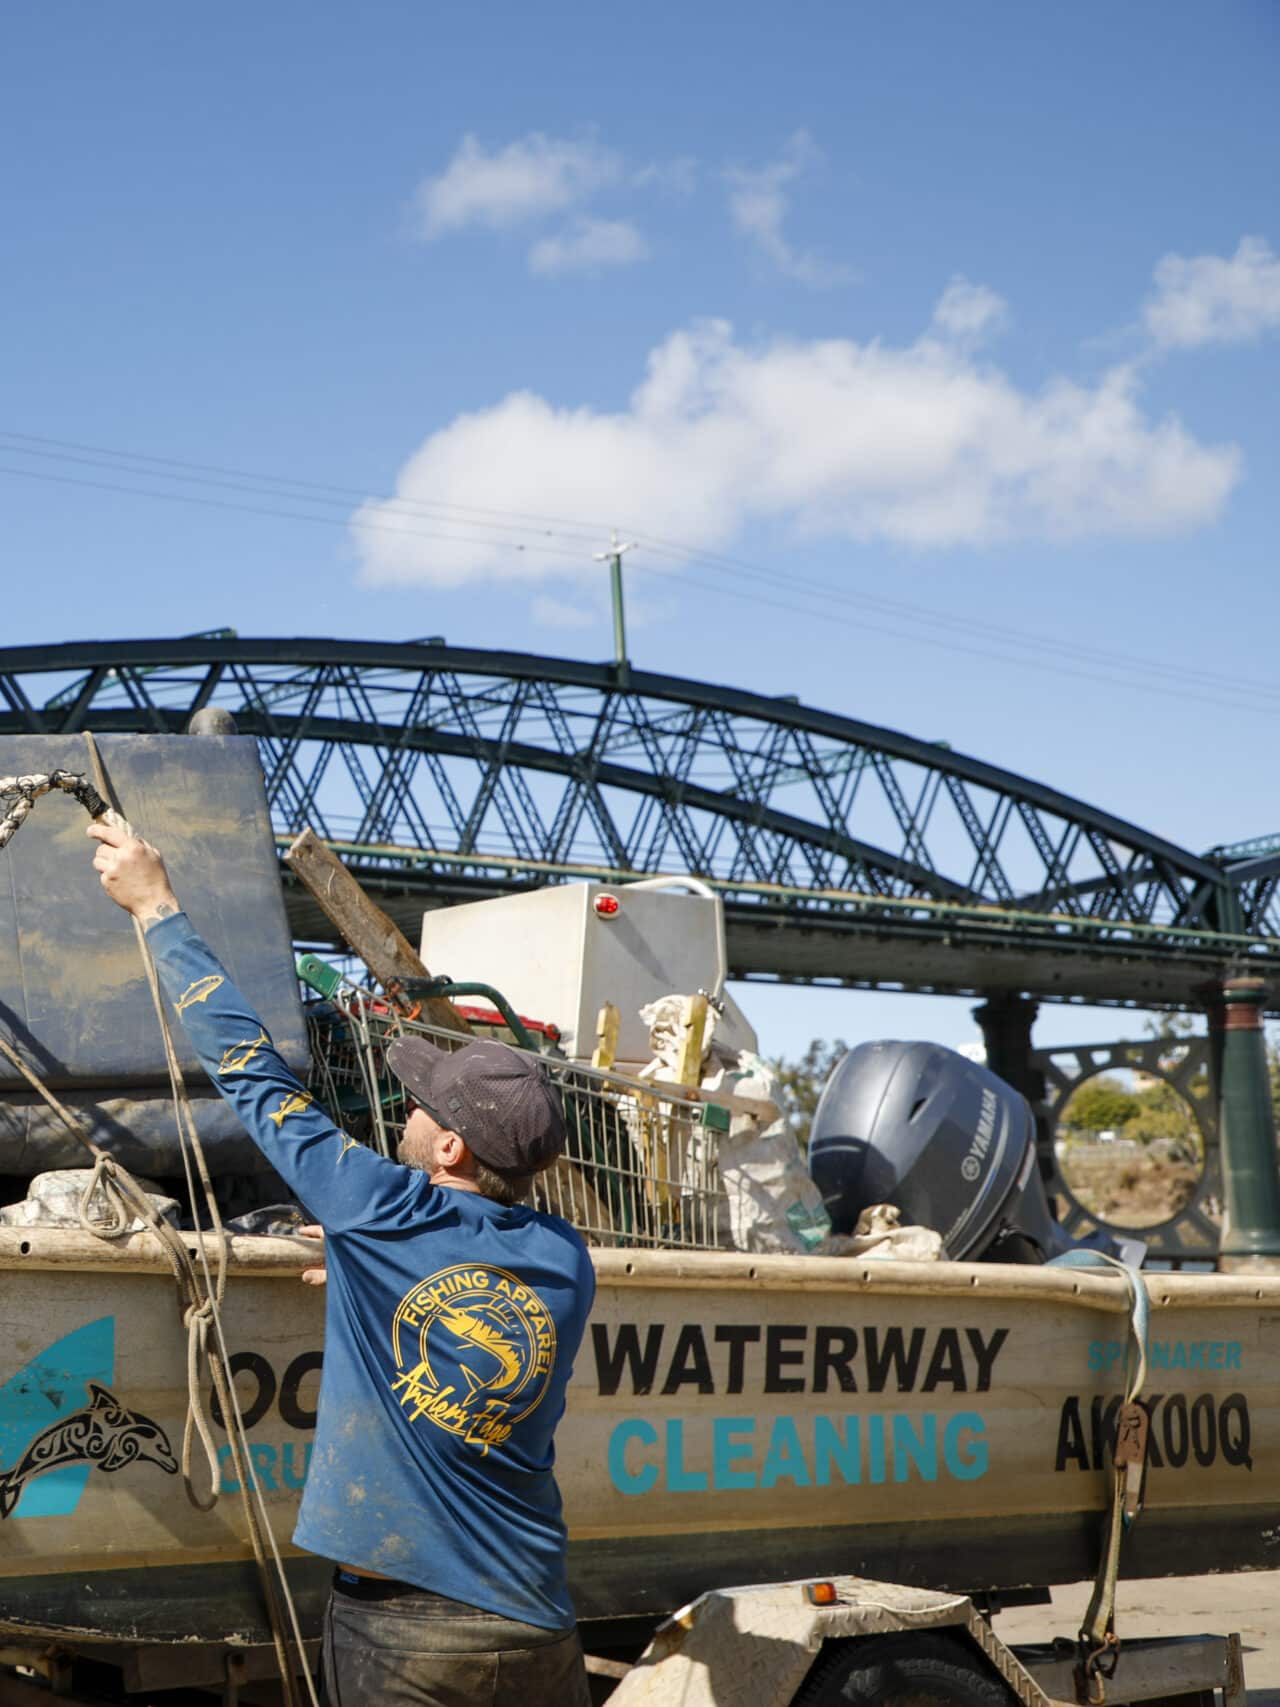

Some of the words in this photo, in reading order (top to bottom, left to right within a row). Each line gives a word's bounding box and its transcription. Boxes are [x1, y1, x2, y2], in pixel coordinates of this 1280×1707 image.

[969, 1088, 998, 1160] YAMAHA
[402, 1270, 489, 1327] FISHING
[495, 1278, 551, 1379] APPAREL
[210, 1351, 325, 1432] OC
[591, 1323, 1011, 1396] WATERWAY
[217, 1442, 314, 1493] CRU
[607, 1411, 990, 1495] CLEANING
